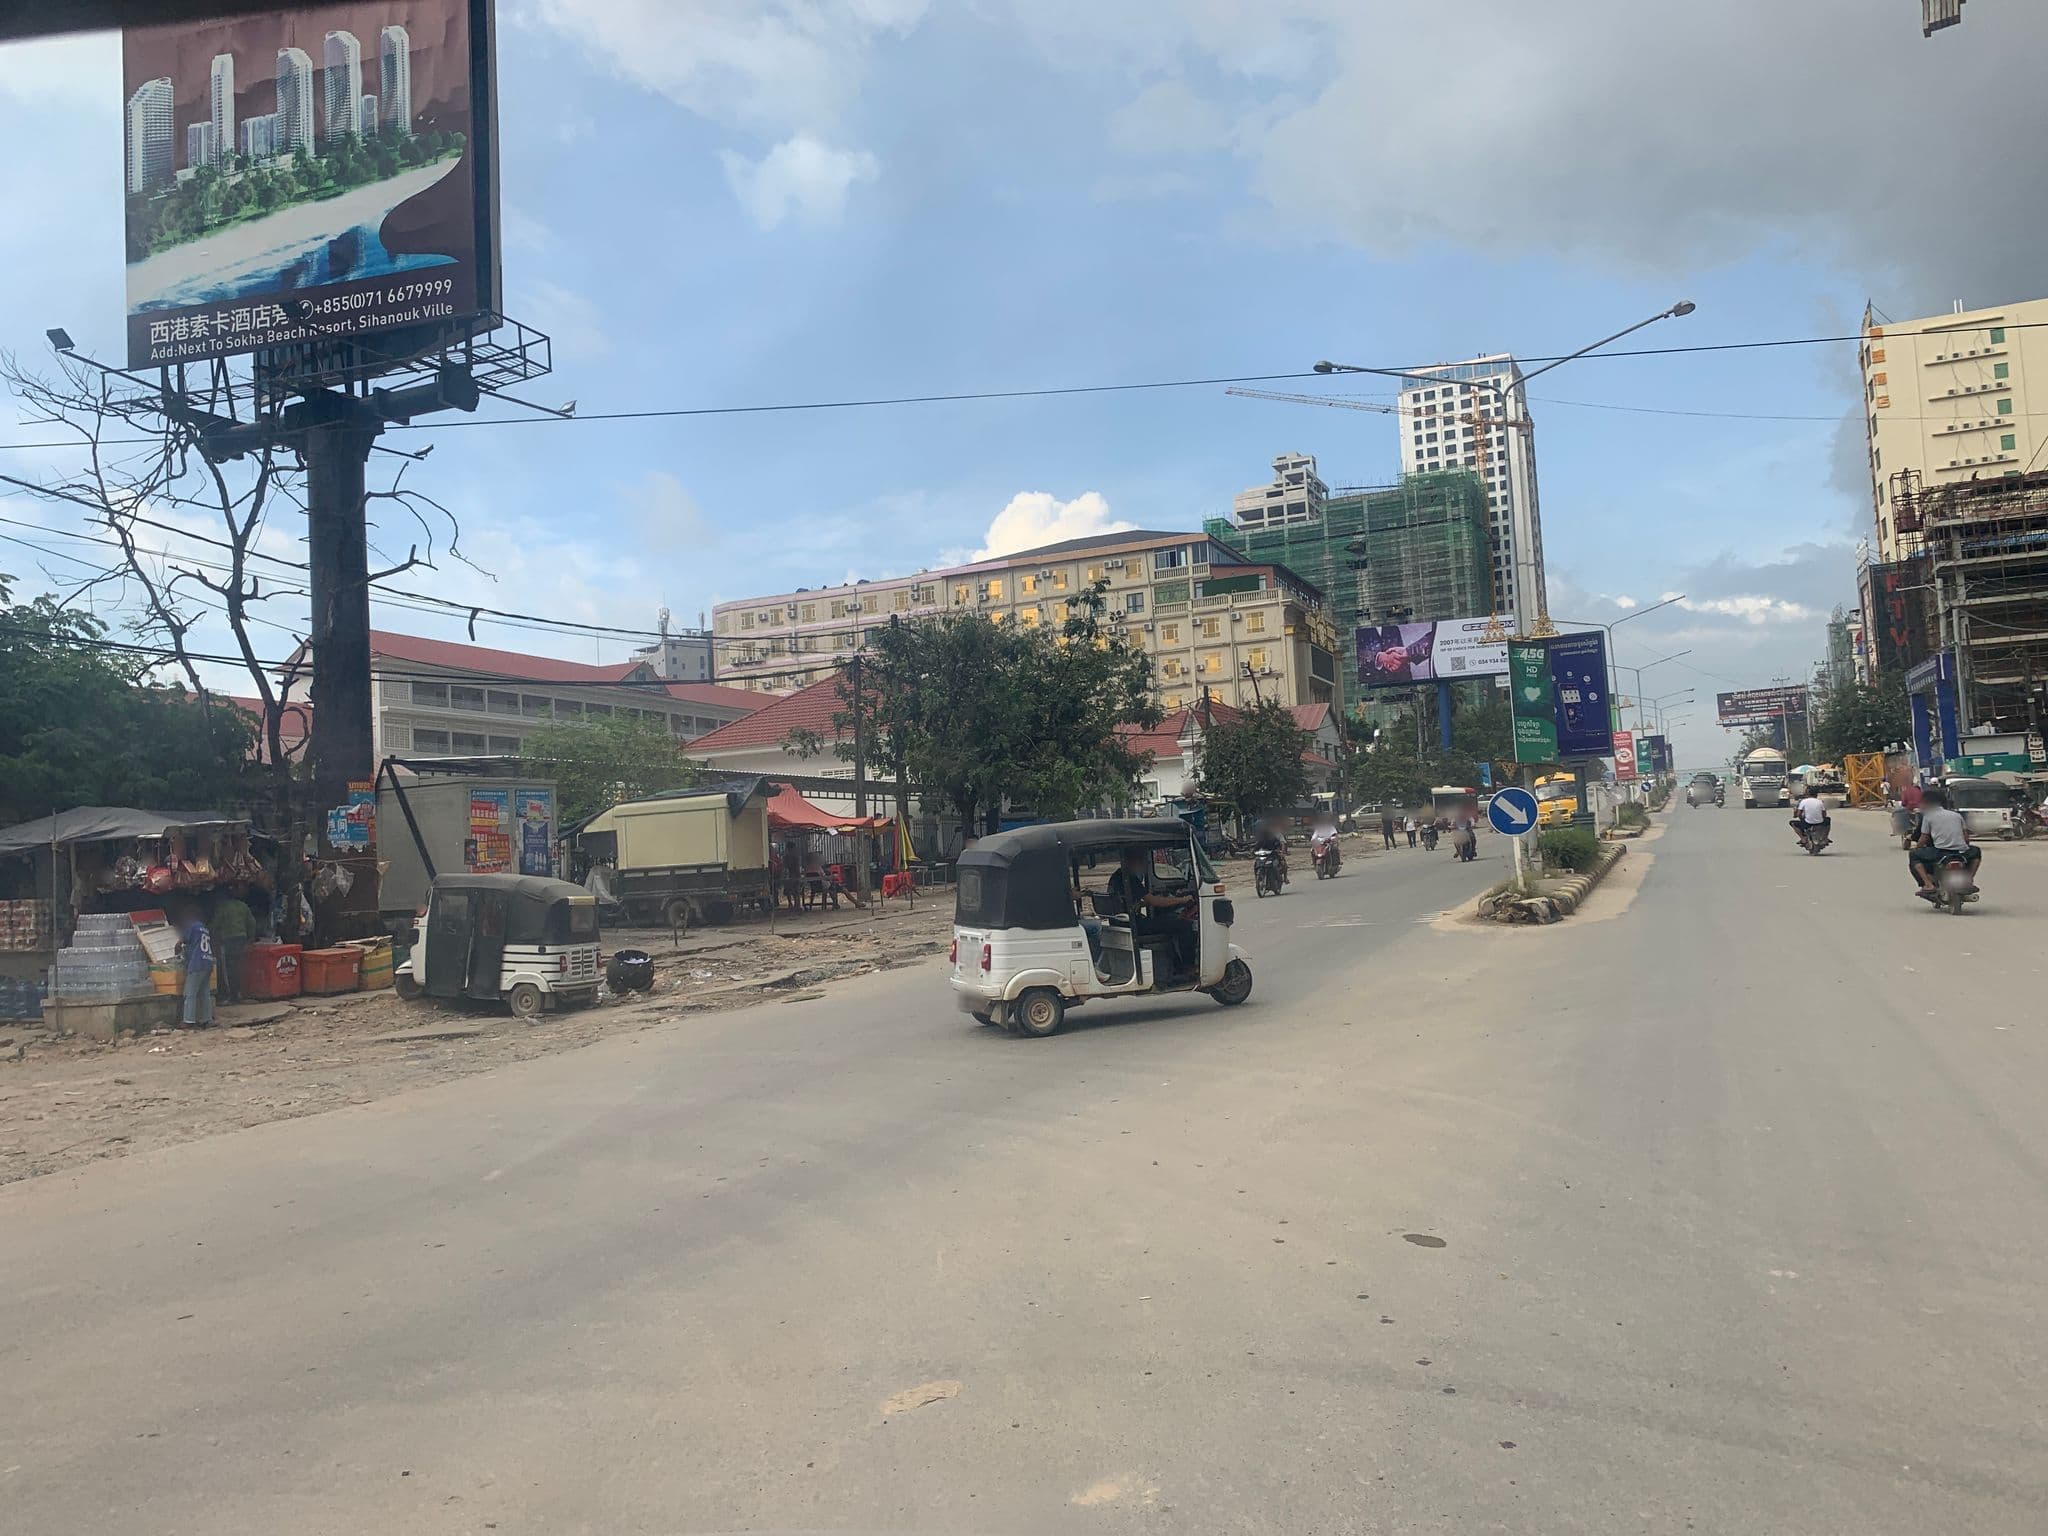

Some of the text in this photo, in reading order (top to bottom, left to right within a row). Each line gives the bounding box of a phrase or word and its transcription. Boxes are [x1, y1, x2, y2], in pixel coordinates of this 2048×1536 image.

[314, 279, 452, 314] +855(0)71 6679999
[151, 302, 453, 360] Add:Next To Sokha Beach Resort, Sihanouk Ville
